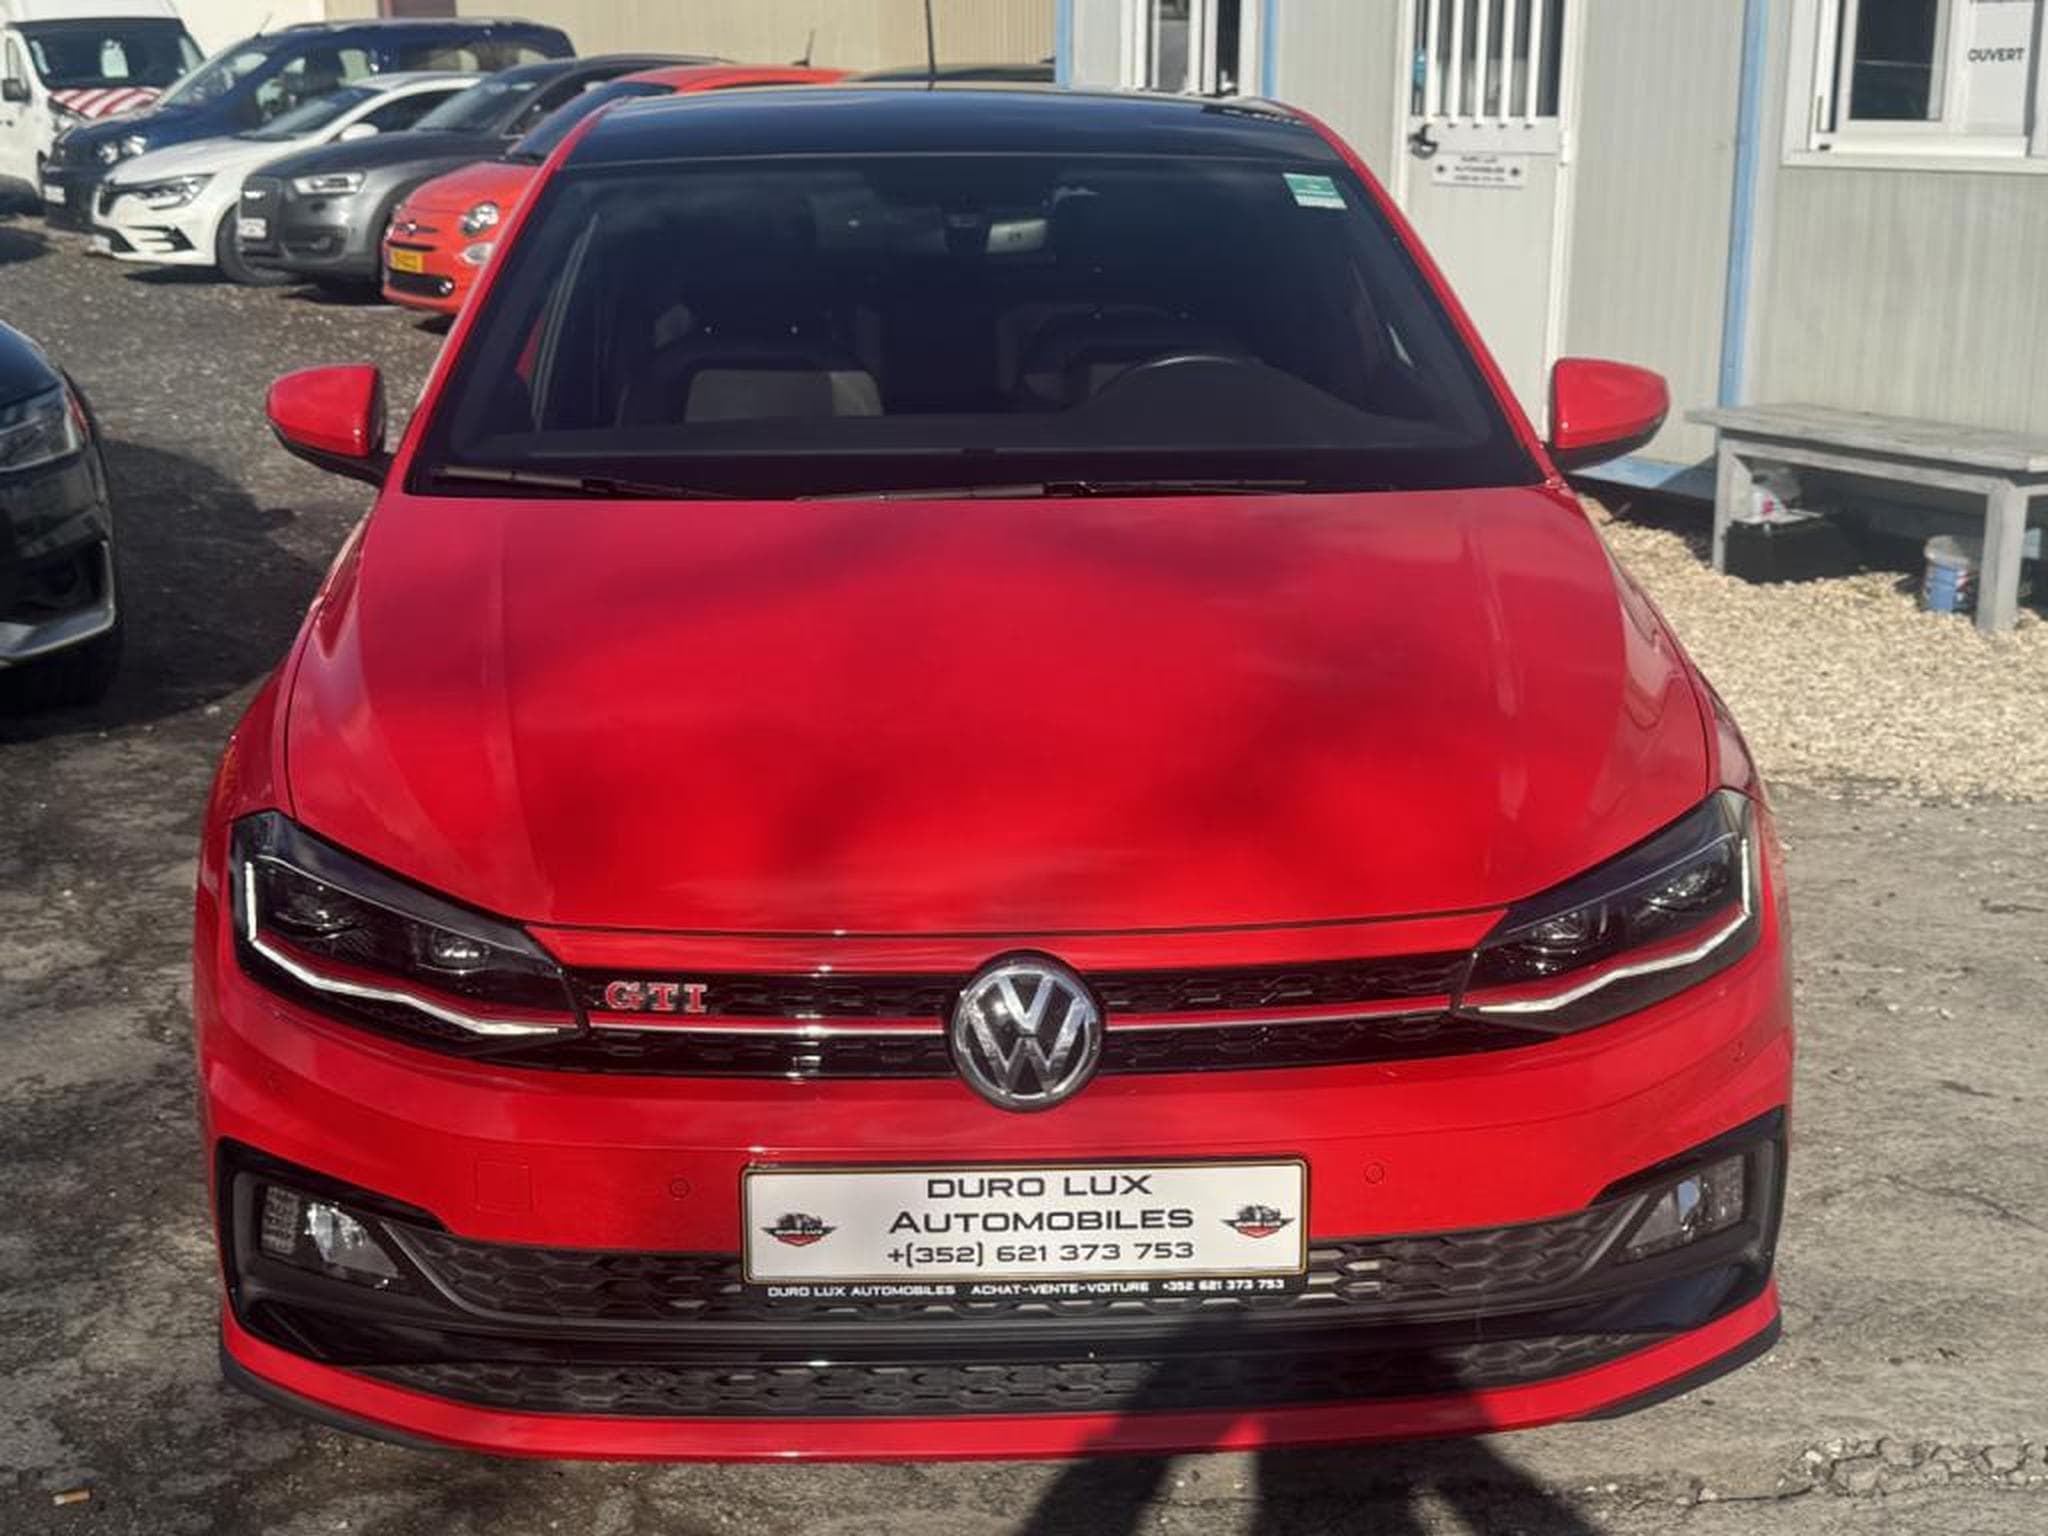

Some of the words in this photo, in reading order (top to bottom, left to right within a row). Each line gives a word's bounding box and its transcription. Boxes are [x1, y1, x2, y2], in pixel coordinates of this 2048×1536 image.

[1967, 47, 2025, 62] OUVERT
[605, 981, 708, 1013] GTI
[927, 1177, 1045, 1199] DURO
[1063, 1175, 1153, 1196] LUX
[888, 1209, 1195, 1234] AUTOMOBILES
[887, 1242, 984, 1267] +(352)
[995, 1245, 1048, 1262] 621
[1059, 1244, 1121, 1261] 373
[1134, 1241, 1195, 1260] 753
[767, 1286, 810, 1297] DURO
[813, 1286, 846, 1297] LUX
[850, 1285, 956, 1296] AUTOMOBILES
[970, 1281, 1150, 1296] ACHAT-VENTE-VOITURE
[1199, 1281, 1223, 1291] 621
[1226, 1280, 1254, 1291] 373
[1257, 1278, 1285, 1290] 753
